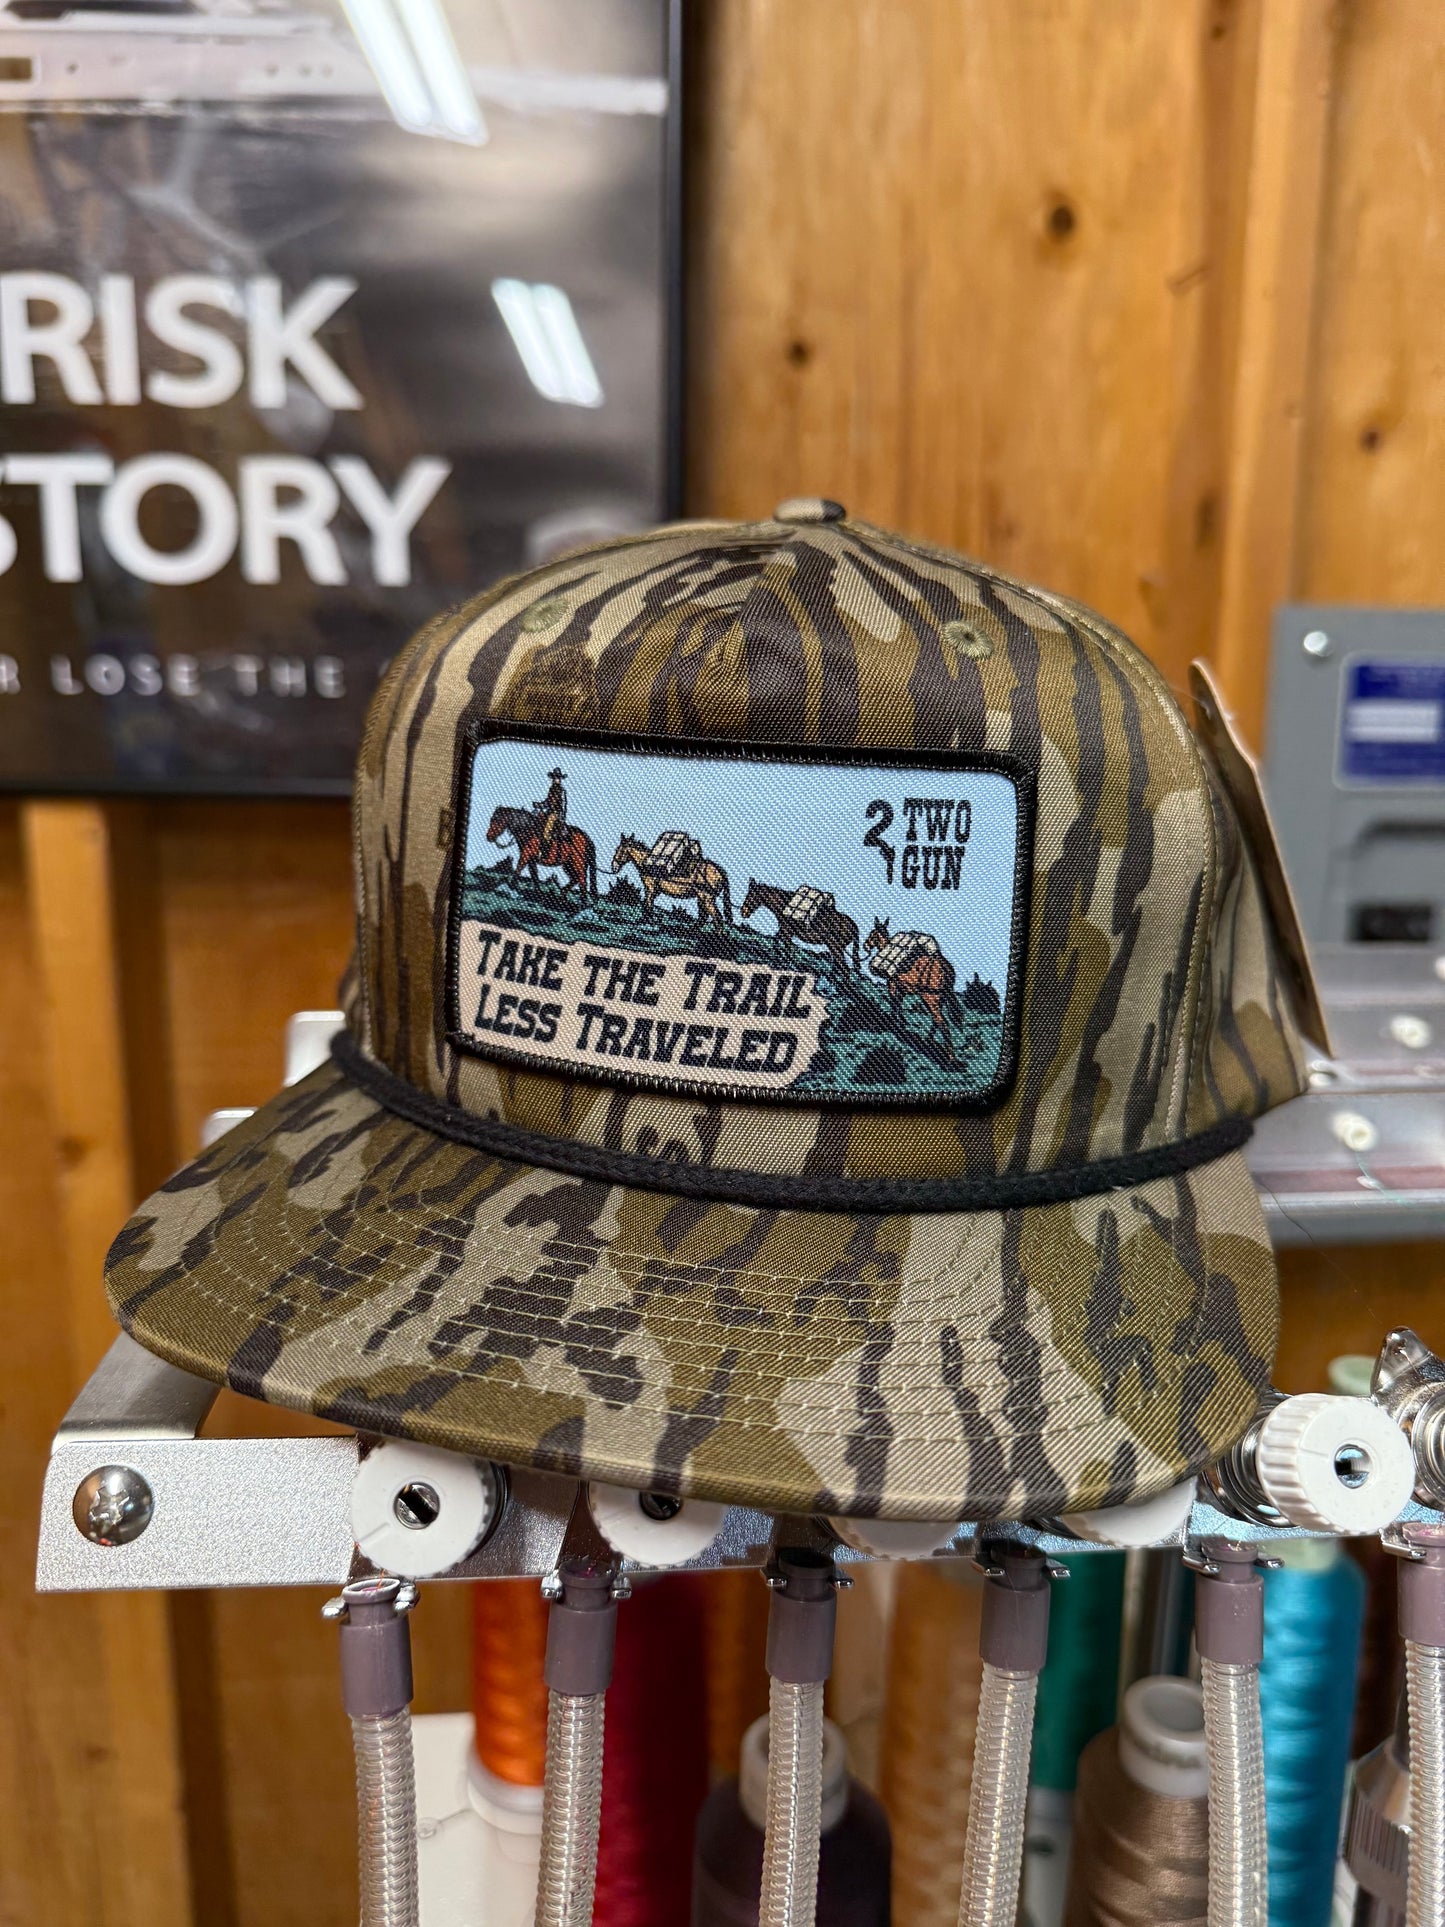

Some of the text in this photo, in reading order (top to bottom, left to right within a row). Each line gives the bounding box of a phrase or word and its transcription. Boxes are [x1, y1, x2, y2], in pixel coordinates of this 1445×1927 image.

[0, 271, 364, 411] RISK
[50, 653, 200, 697] LOSE
[233, 653, 346, 698] THE
[903, 797, 972, 844] TWO
[902, 845, 966, 890] GUN
[478, 929, 811, 1019] TAKE THE TRAIL
[474, 983, 798, 1073] LESS TRAVELED
